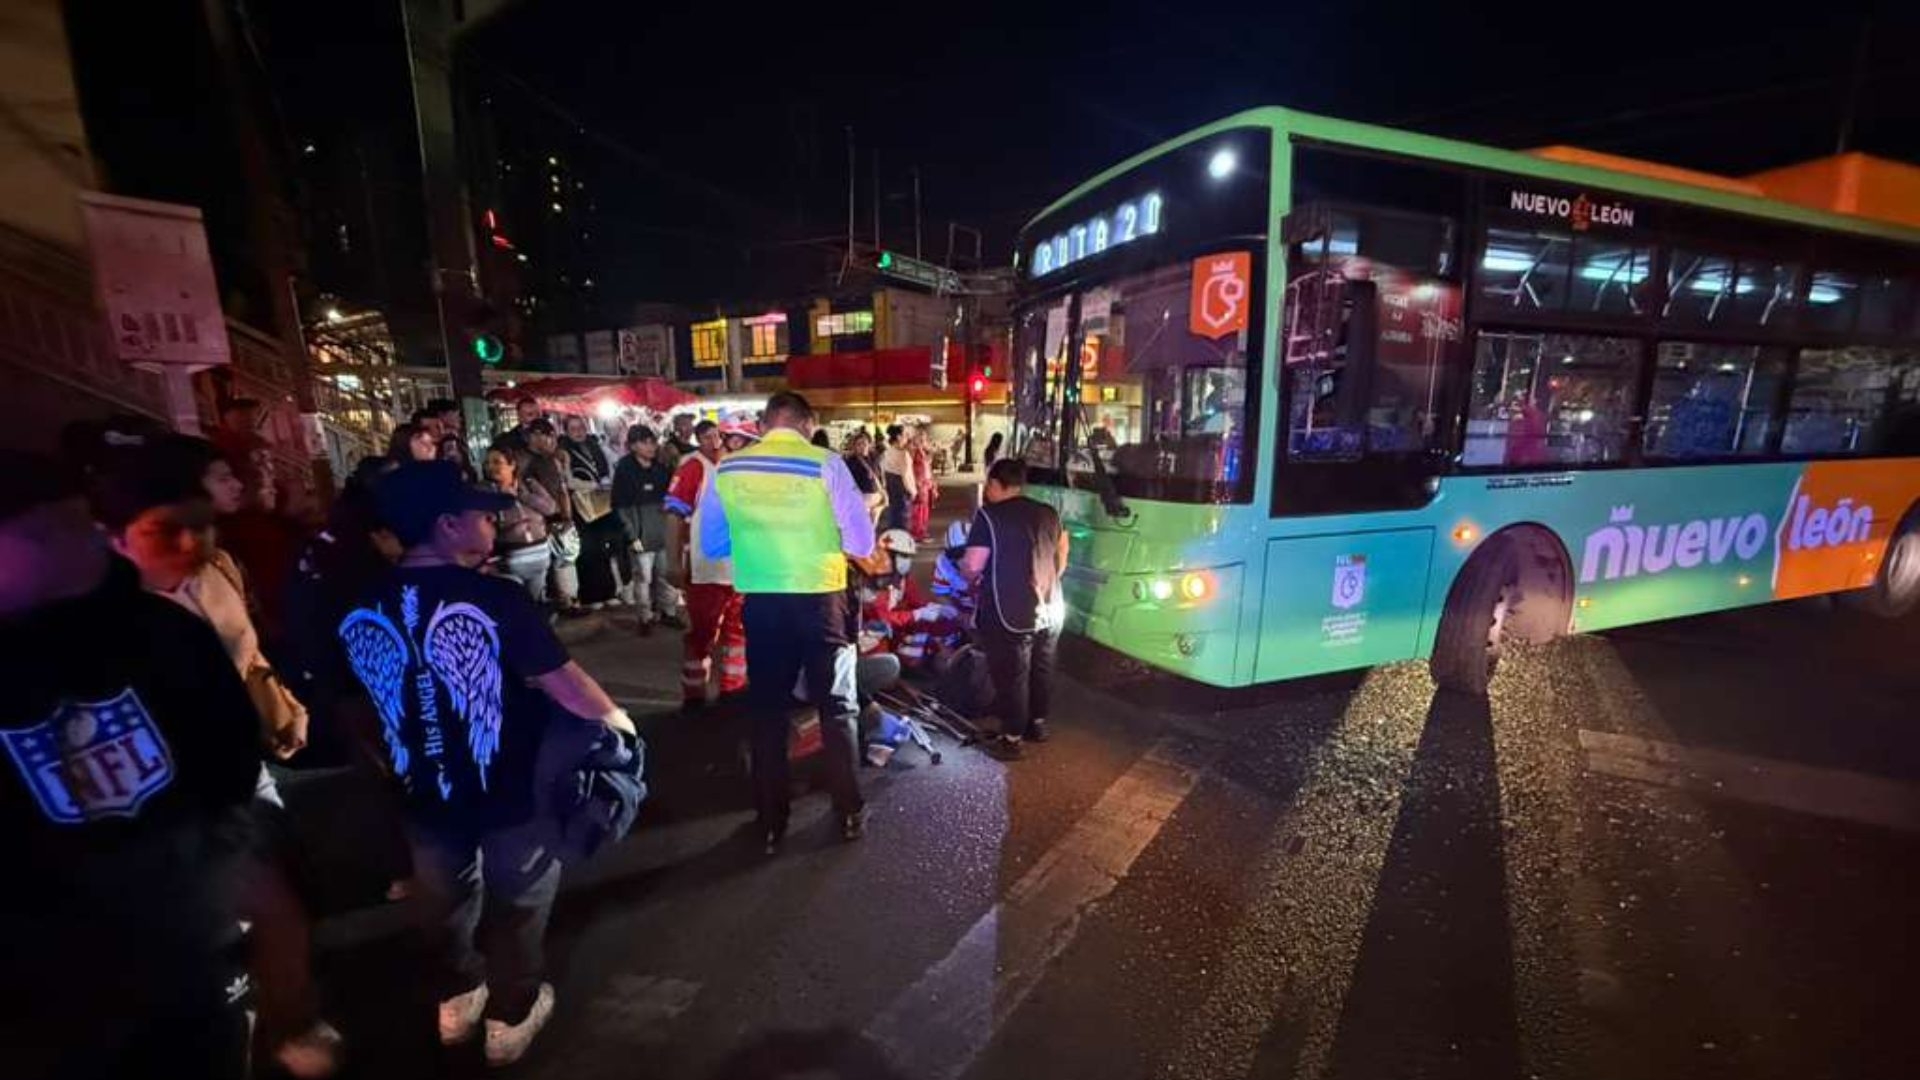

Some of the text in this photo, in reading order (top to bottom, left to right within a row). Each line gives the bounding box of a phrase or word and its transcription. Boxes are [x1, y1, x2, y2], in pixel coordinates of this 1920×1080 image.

[1034, 188, 1161, 275] RUTA 20
[1510, 190, 1635, 227] NUEVO LEÓN
[1788, 495, 1873, 550] león
[415, 667, 446, 757] HIS ANGEL
[36, 727, 166, 815] NFL
